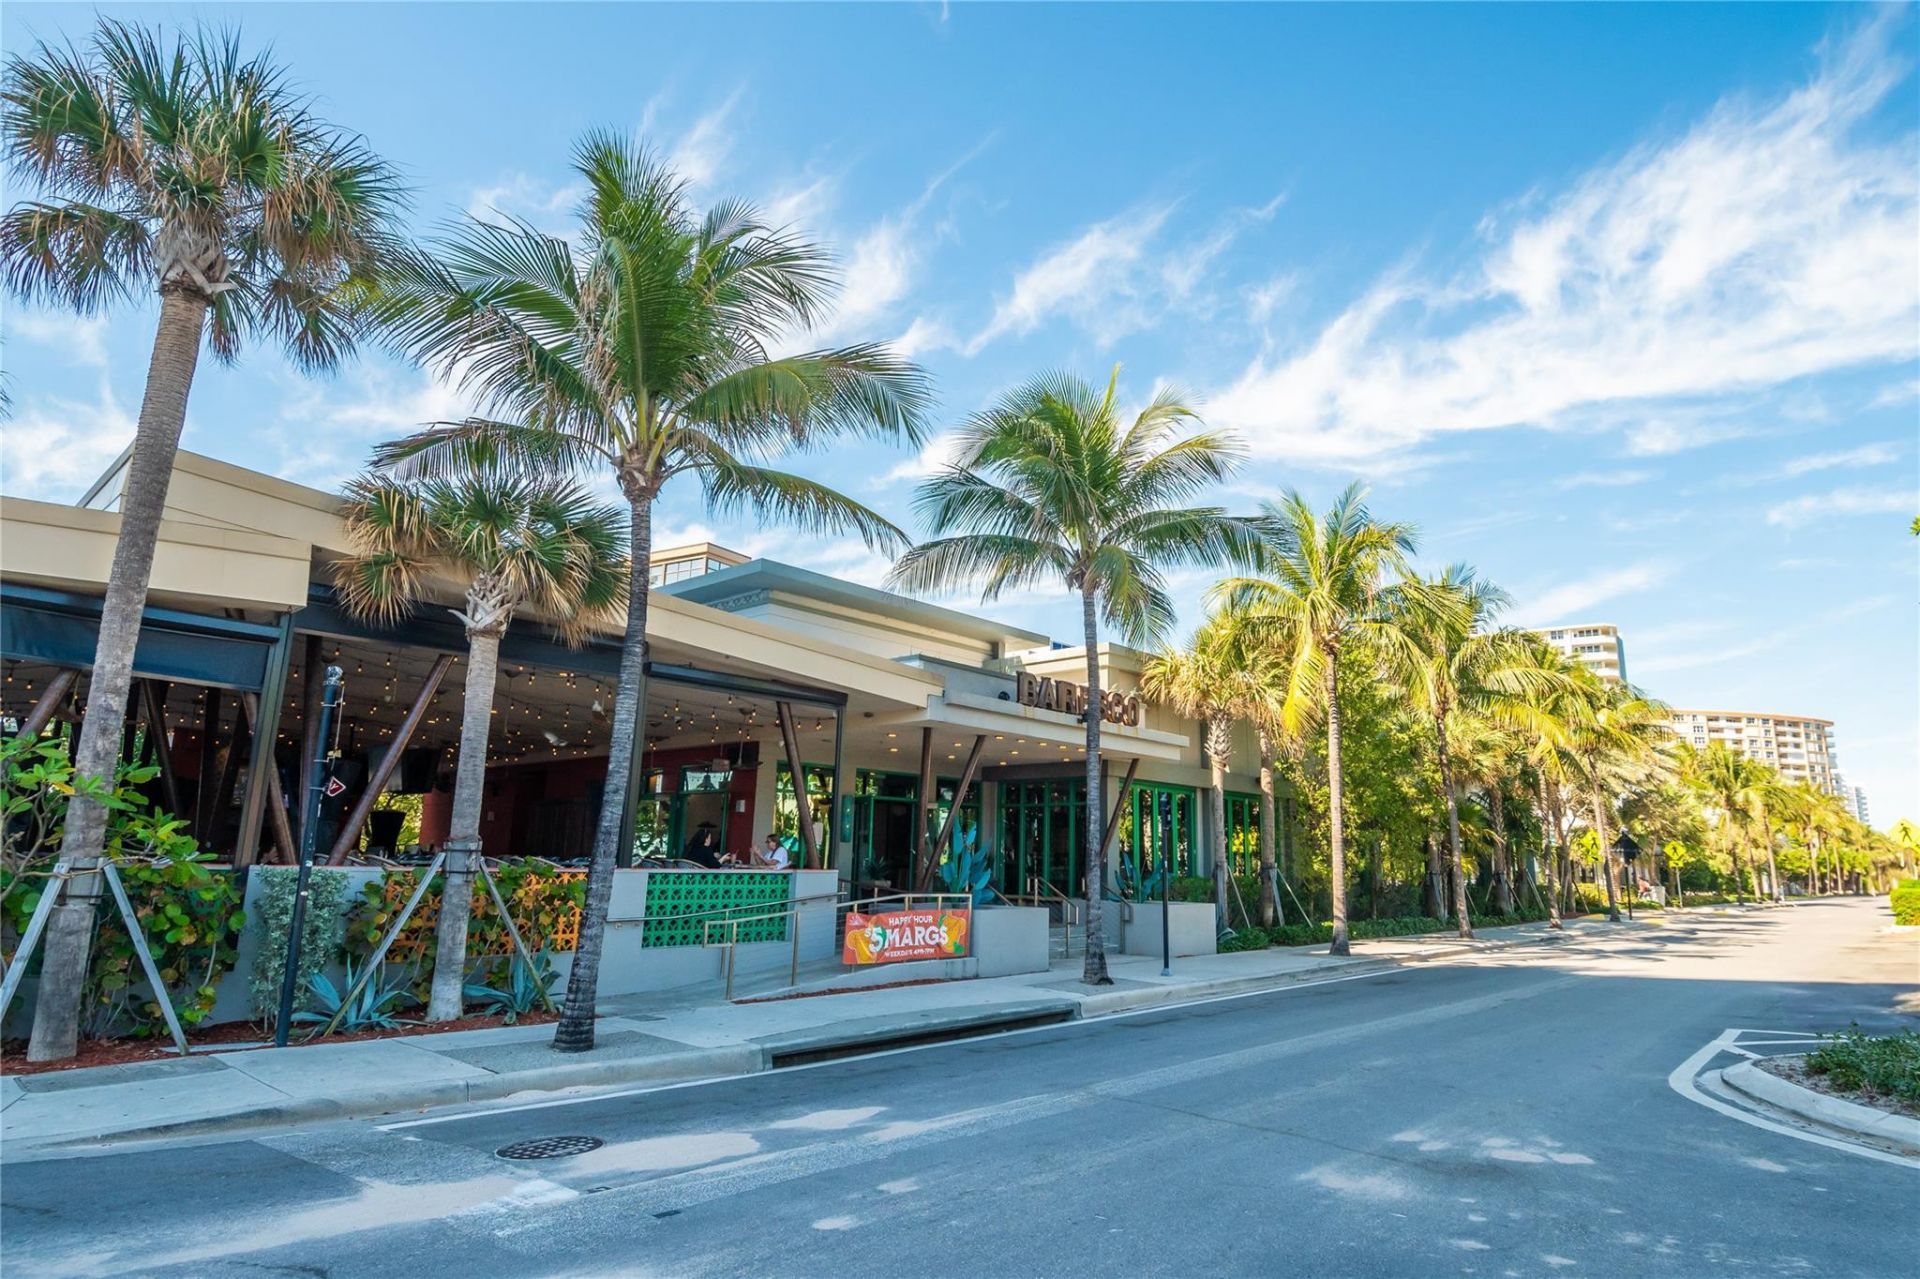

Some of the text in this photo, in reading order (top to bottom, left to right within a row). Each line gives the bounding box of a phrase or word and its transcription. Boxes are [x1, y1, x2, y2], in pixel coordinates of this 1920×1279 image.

[889, 915, 933, 925] HAPPY HOUR
[884, 926, 948, 949] MARGS
